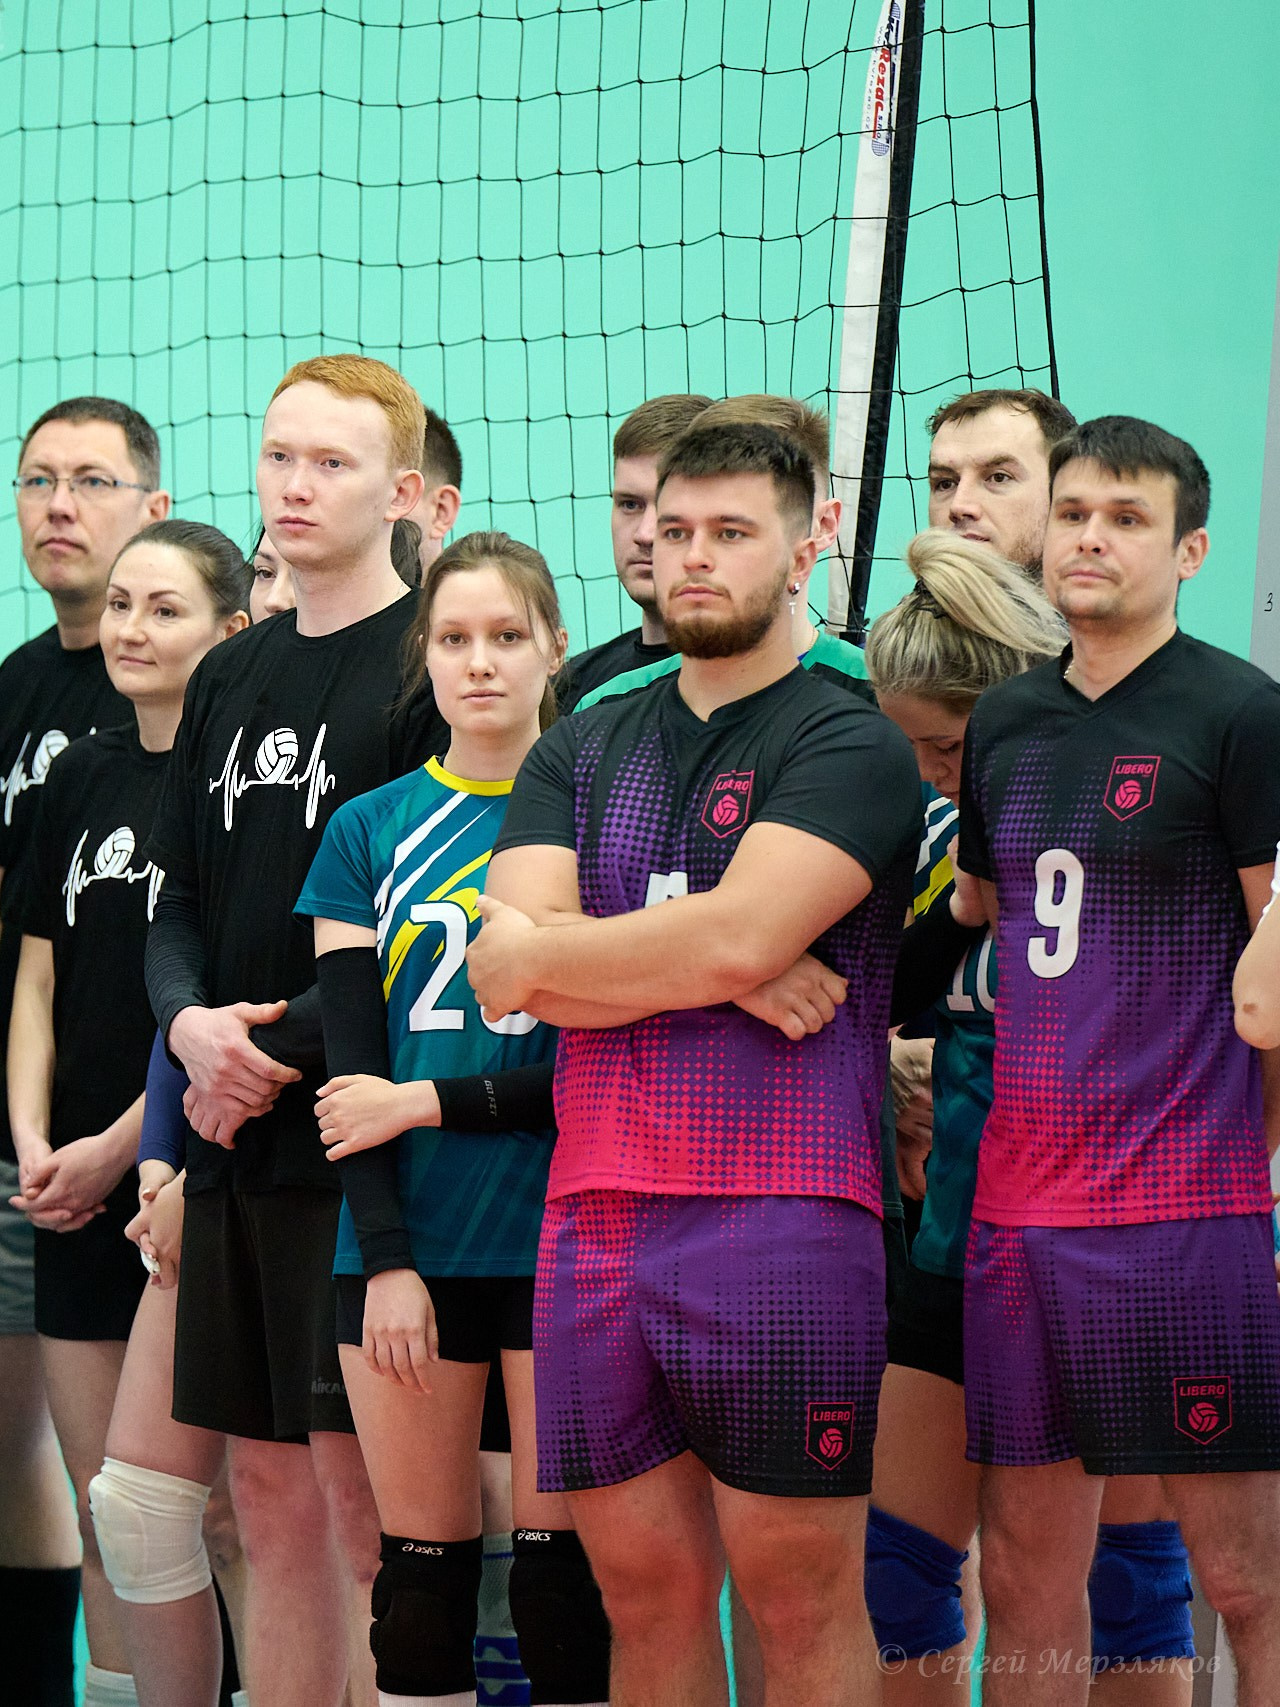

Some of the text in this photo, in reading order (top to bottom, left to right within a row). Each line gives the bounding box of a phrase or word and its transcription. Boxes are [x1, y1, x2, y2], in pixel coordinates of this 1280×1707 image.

[1115, 763, 1154, 775] LIBERO
[1027, 848, 1084, 979] 9
[1179, 1385, 1226, 1397] LIBERO
[813, 1411, 851, 1421] LIBERO
